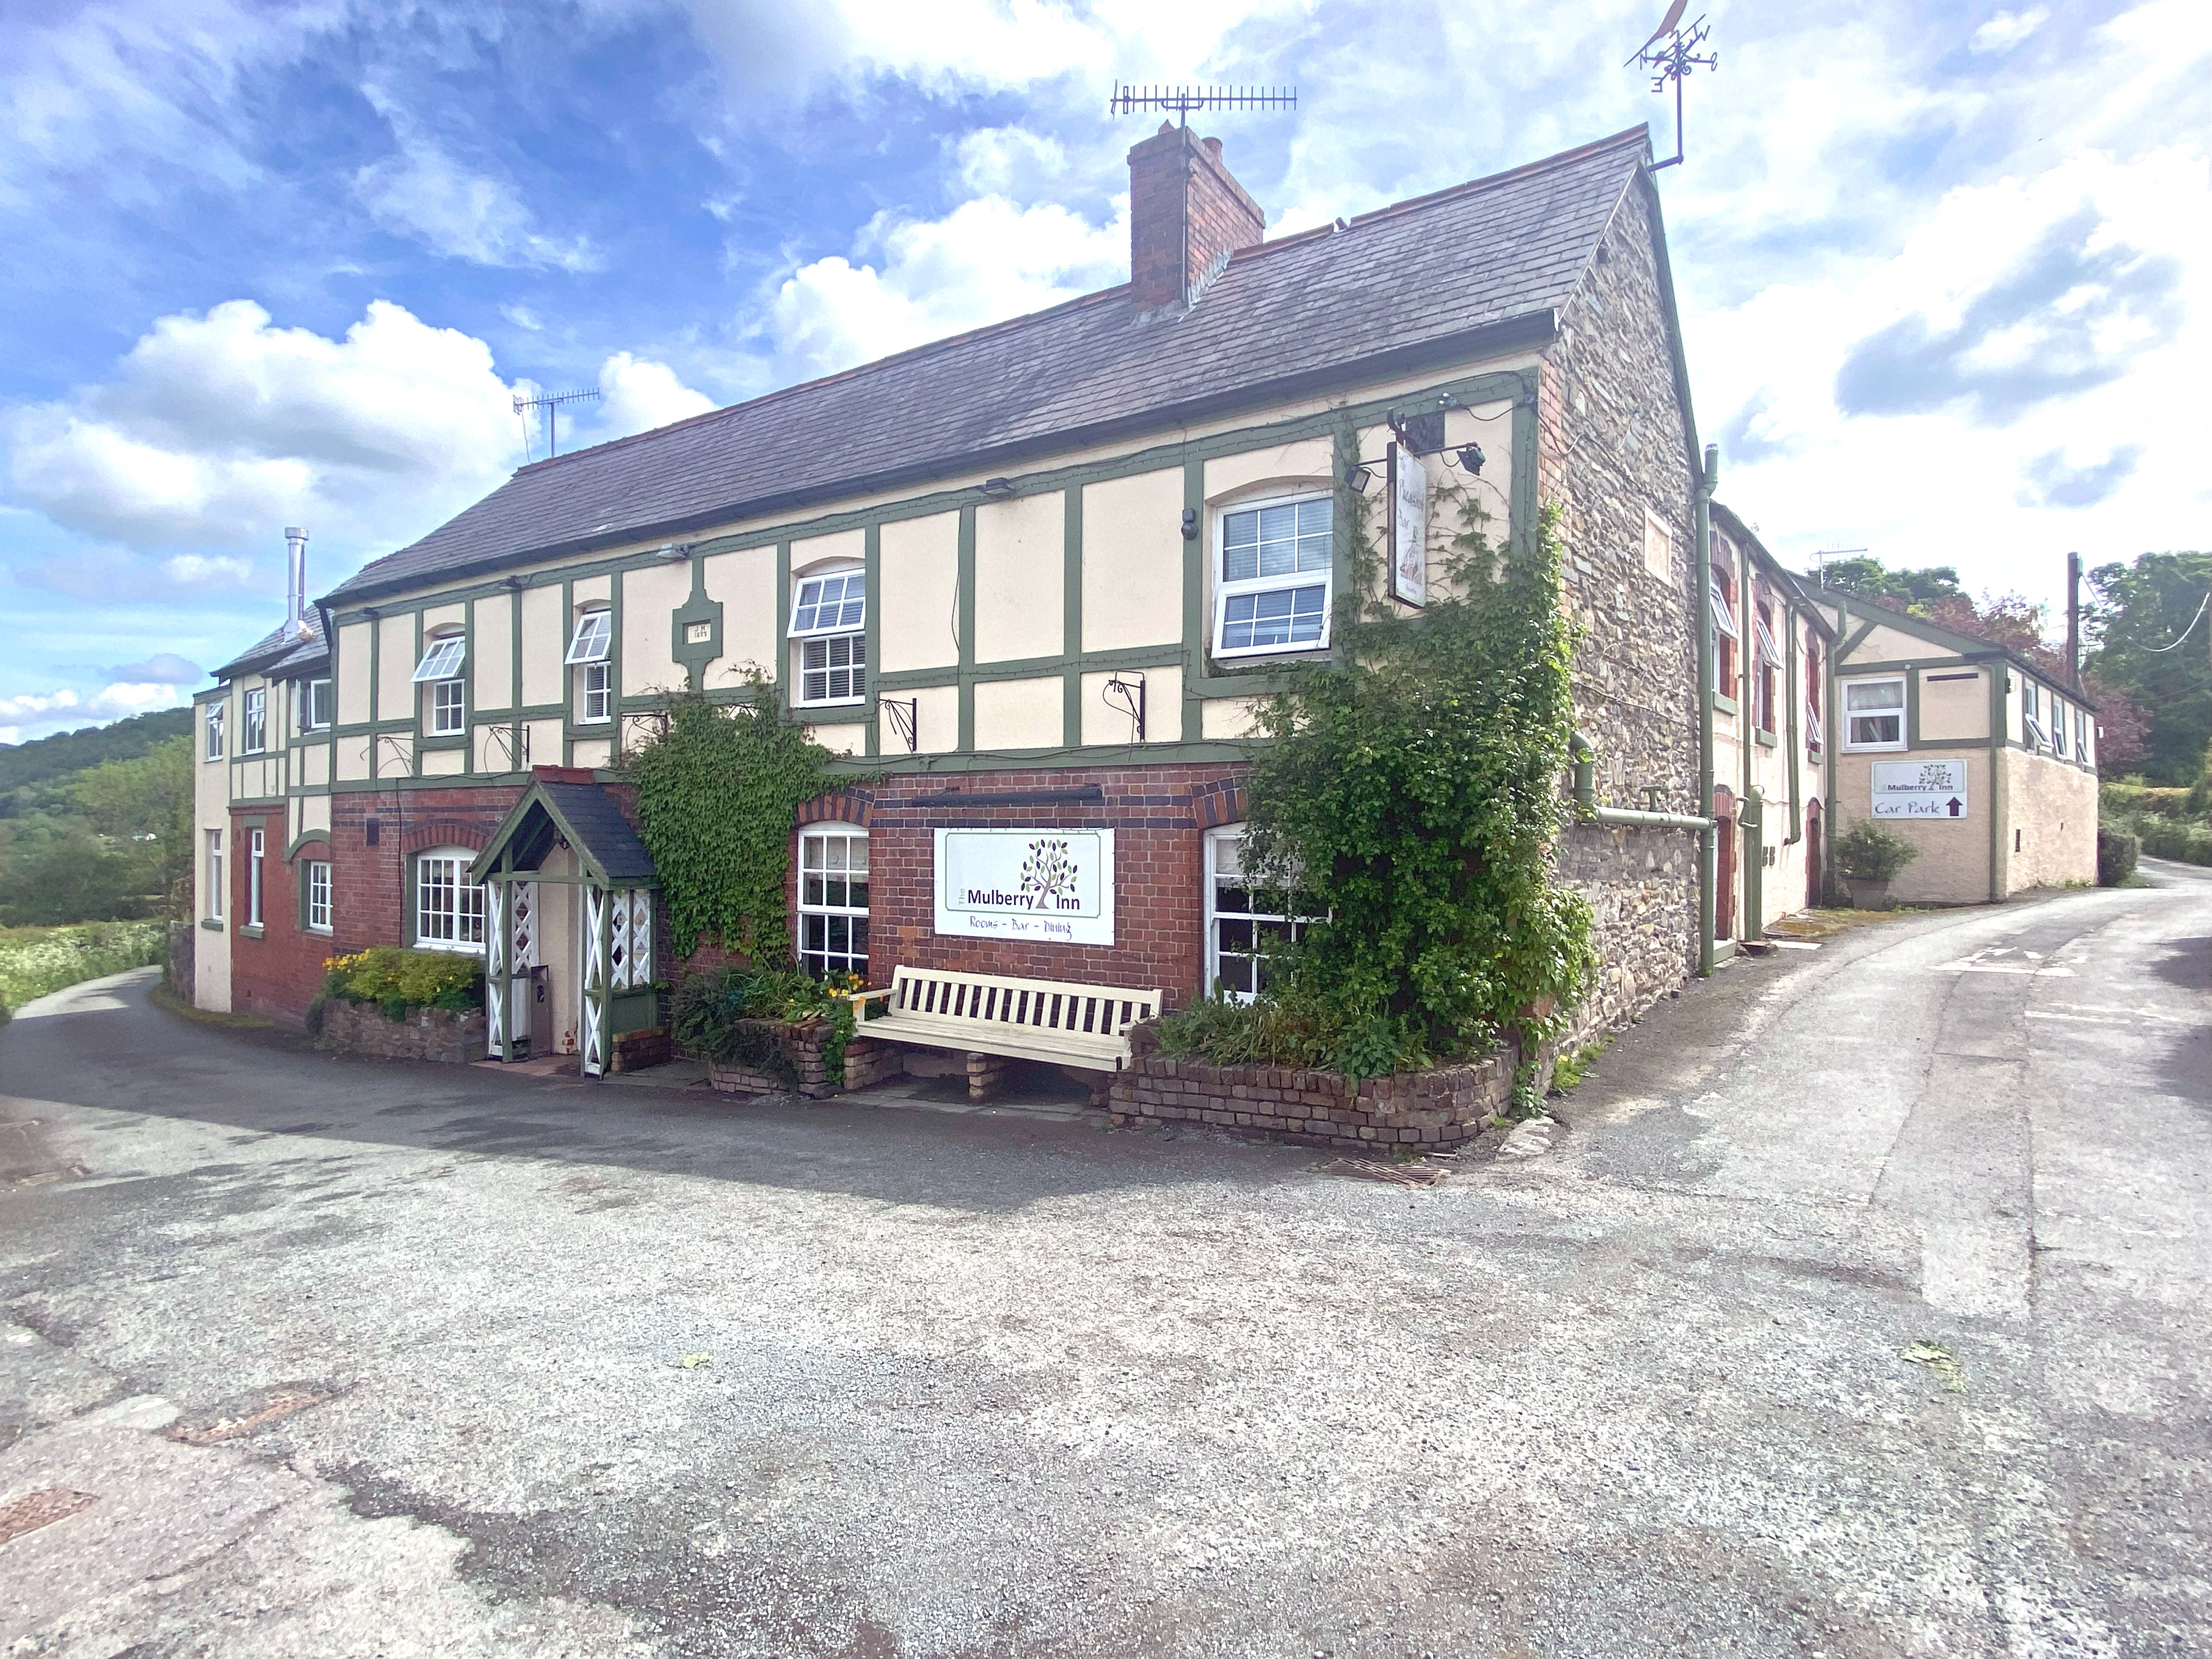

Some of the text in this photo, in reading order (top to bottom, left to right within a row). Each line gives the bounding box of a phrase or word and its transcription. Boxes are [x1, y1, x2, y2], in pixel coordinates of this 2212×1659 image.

[1875, 800, 1940, 814] Car Park
[968, 889, 1034, 910] Mulberry
[1056, 894, 1080, 910] Inn
[969, 916, 998, 929] Rooms
[1012, 918, 1030, 931] Bar
[1043, 919, 1072, 941] Dining
